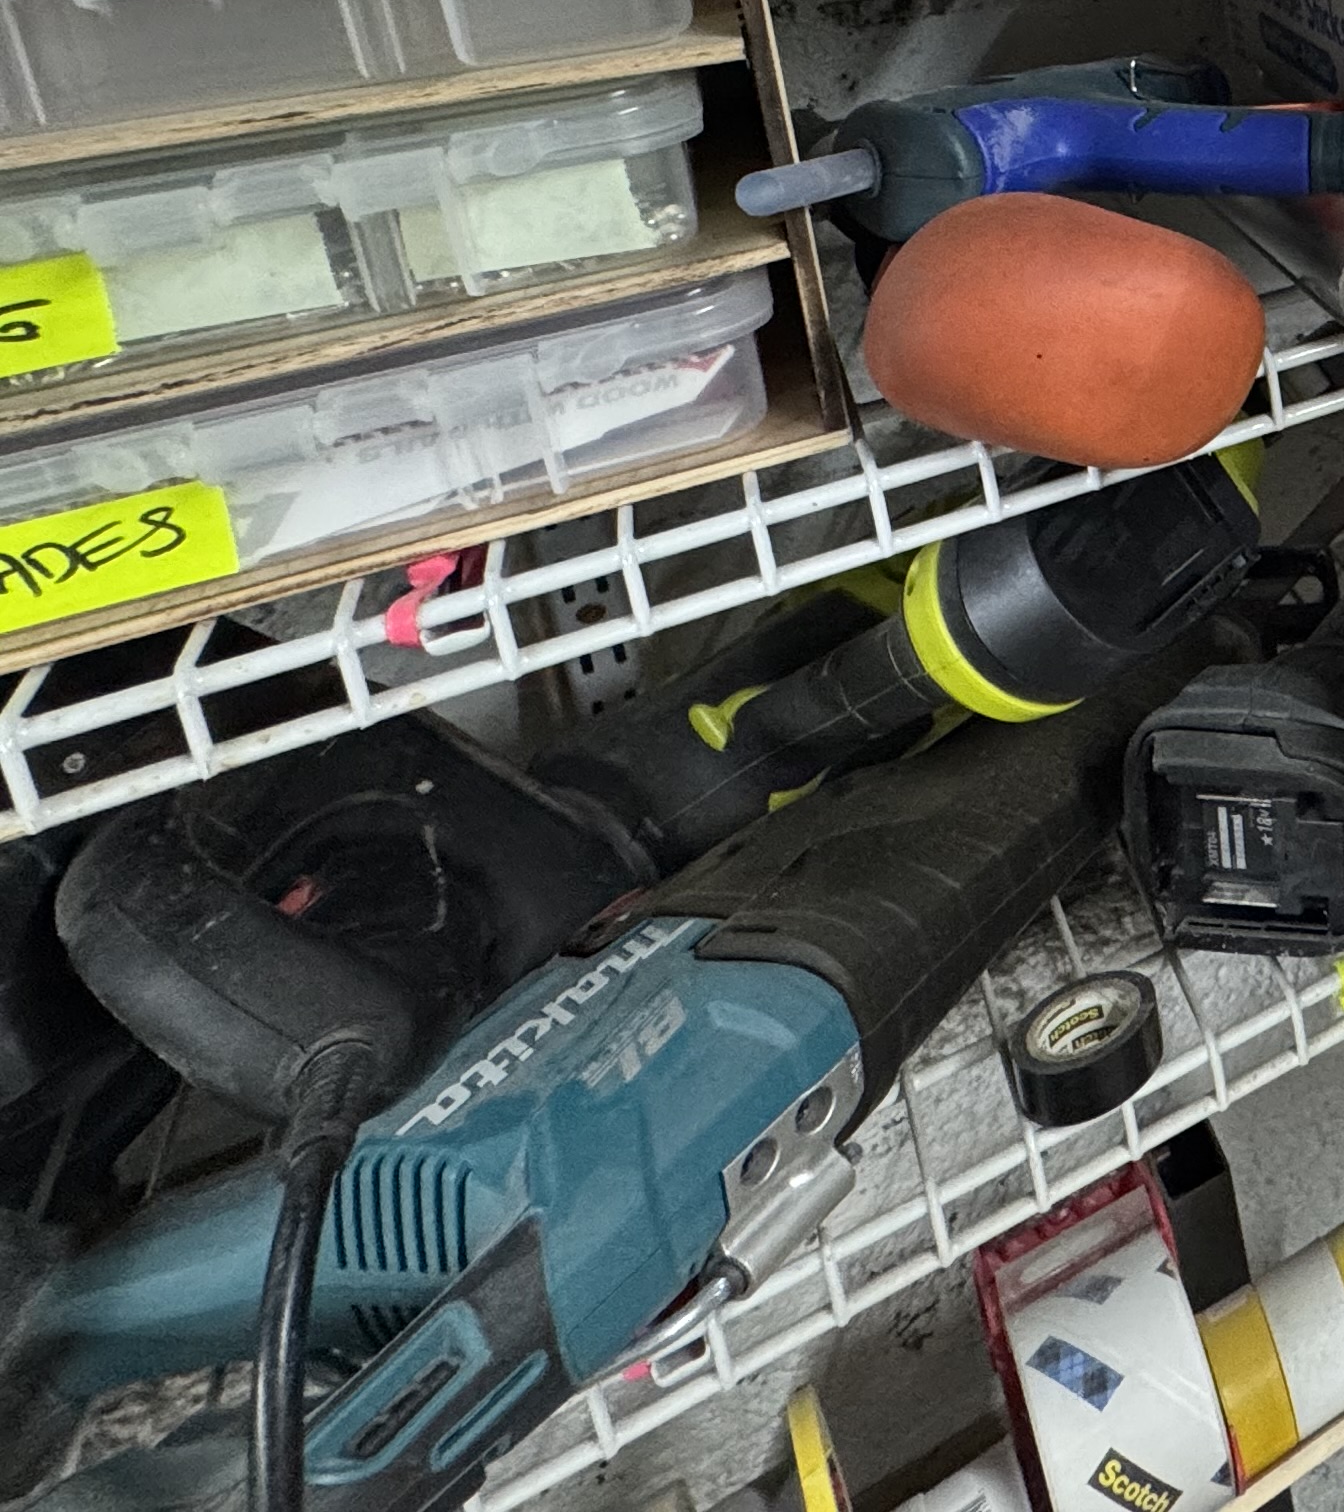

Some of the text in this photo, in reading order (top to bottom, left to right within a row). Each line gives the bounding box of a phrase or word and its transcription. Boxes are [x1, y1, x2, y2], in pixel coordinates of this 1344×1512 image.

[576, 374, 679, 411] WOOD
[1050, 1007, 1101, 1041] Scotch
[1098, 1458, 1171, 1512] Scotch
